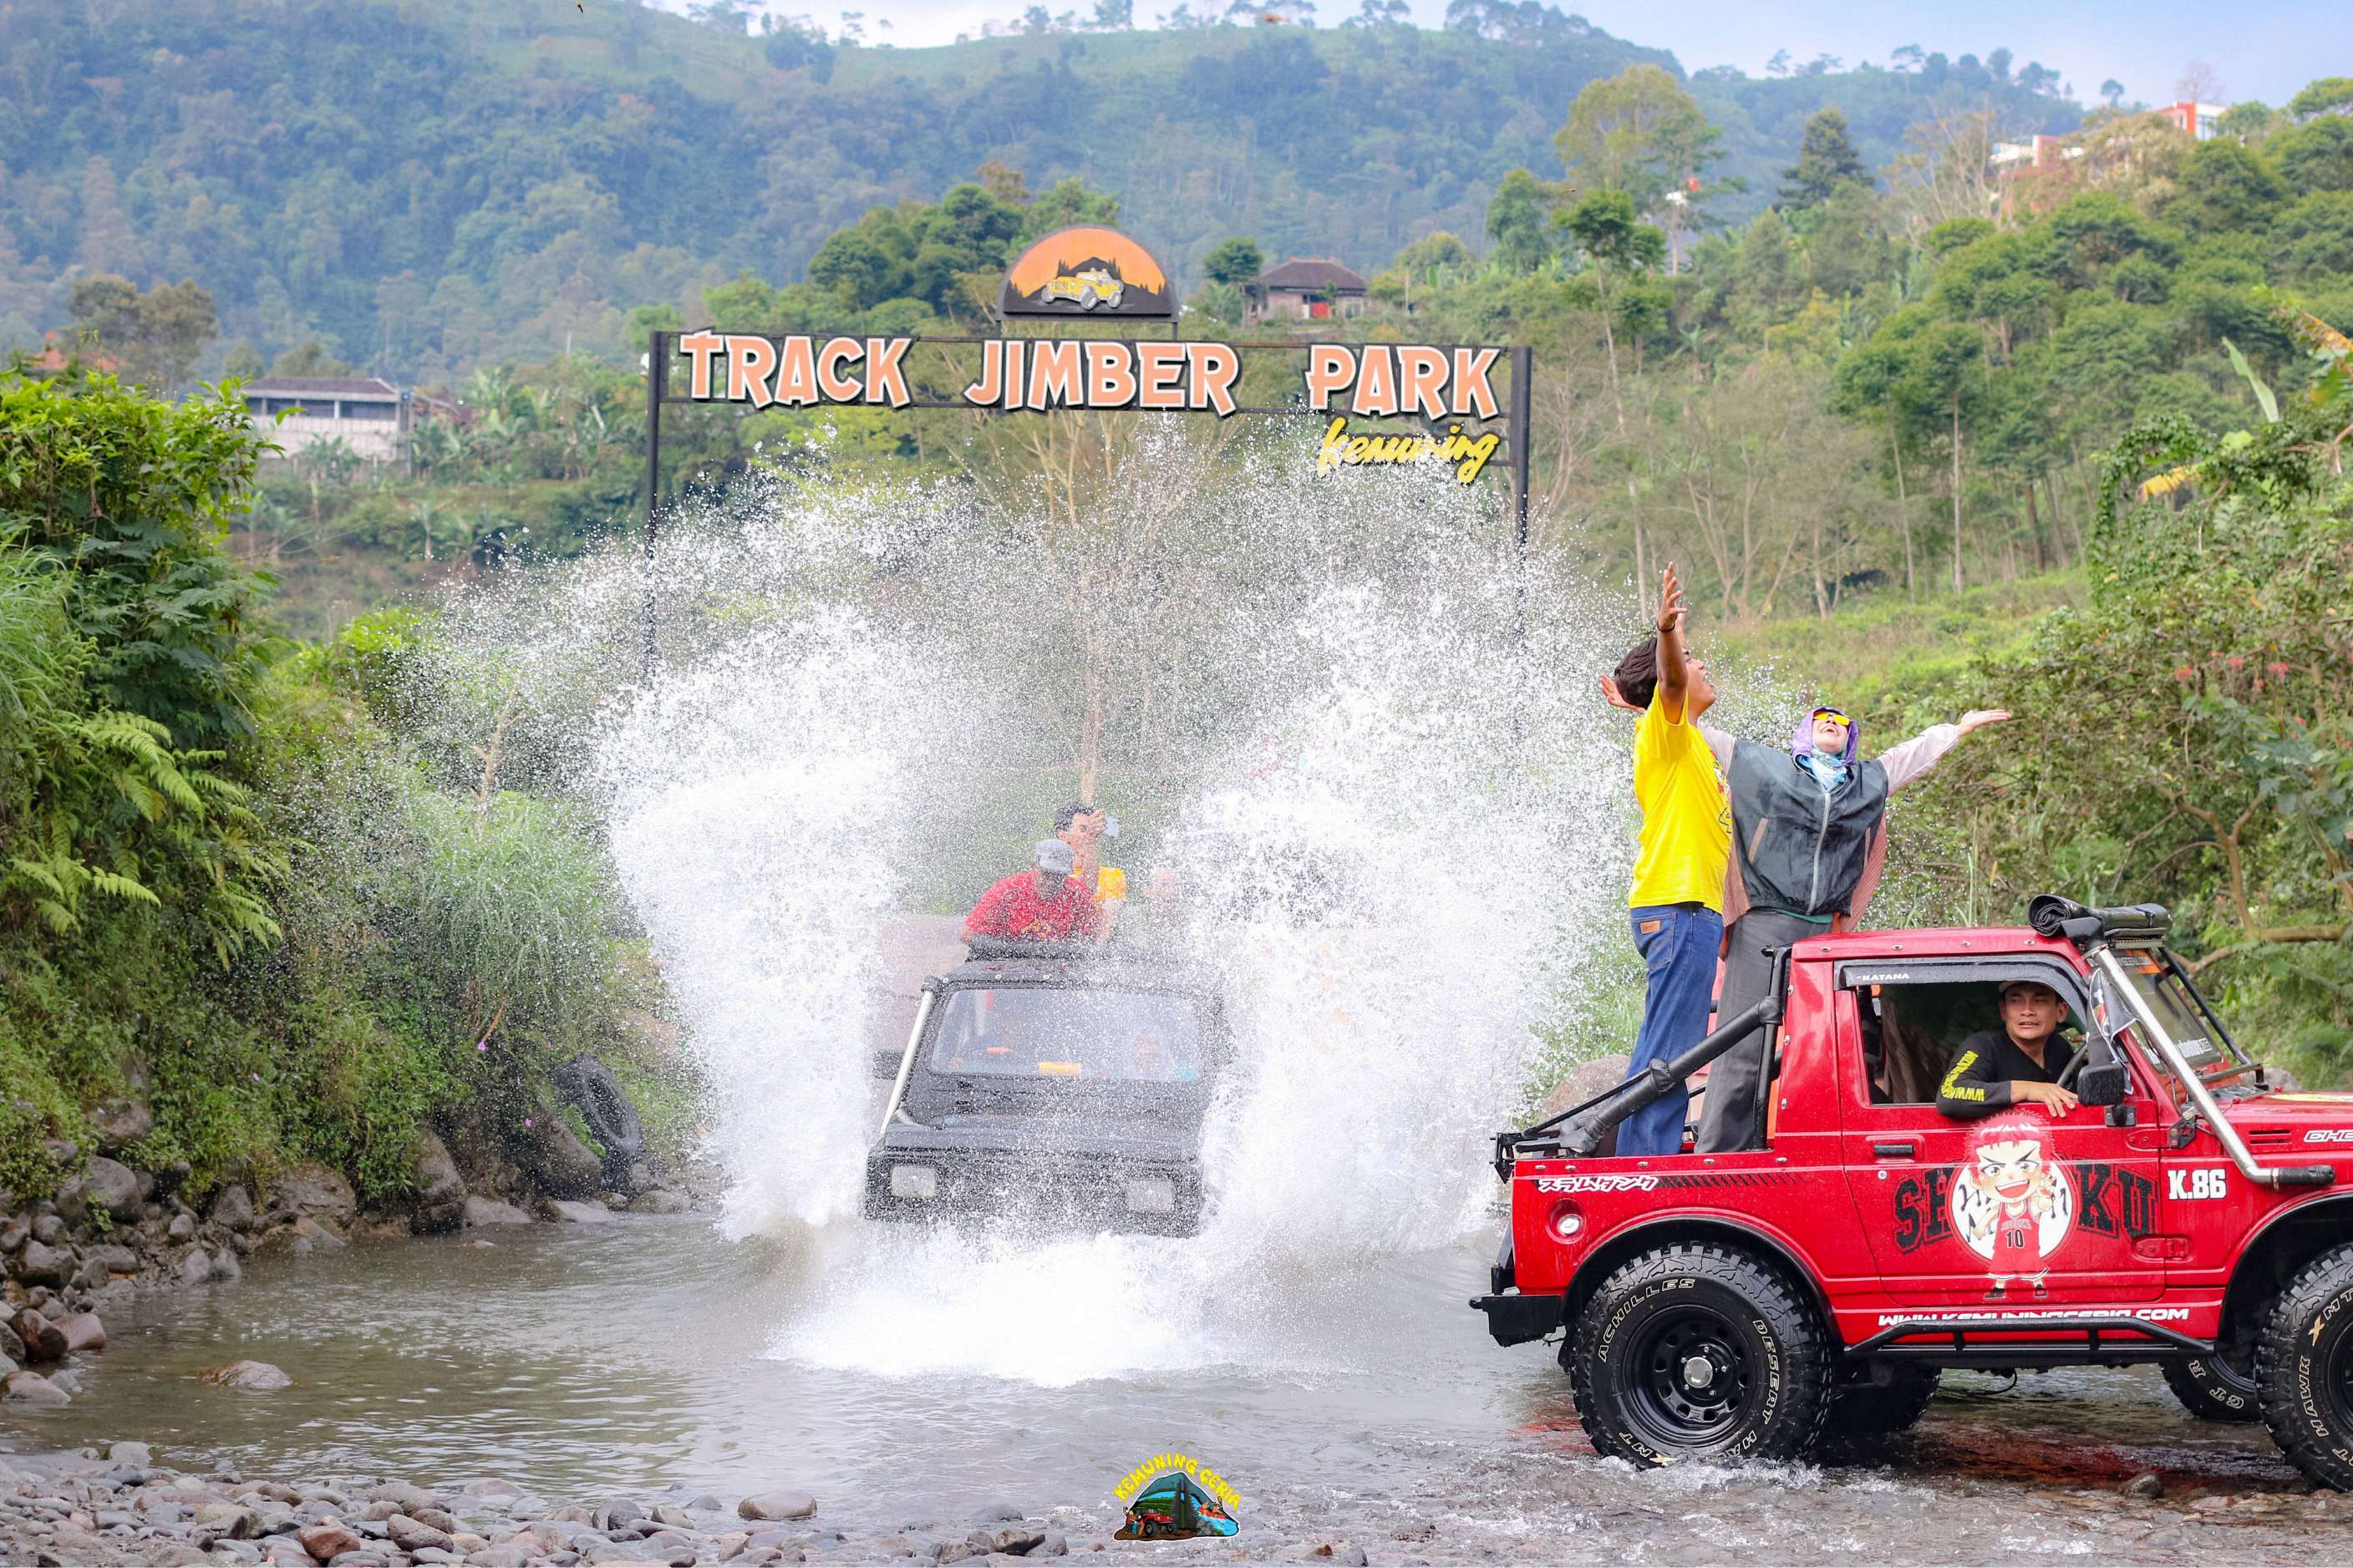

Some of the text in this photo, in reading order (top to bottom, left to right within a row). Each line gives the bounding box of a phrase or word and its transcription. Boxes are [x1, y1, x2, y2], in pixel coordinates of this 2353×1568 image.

[680, 330, 1501, 420] TRACK JIMBER PARK
[1862, 973, 1910, 982] KATANA
[1893, 1156, 2159, 1255] SHKU
[2168, 1169, 2227, 1200] K.86
[2005, 1229, 2025, 1249] 10
[1598, 1278, 1696, 1362] ACHILLES
[1718, 1319, 1780, 1458] DESERT HA
[2299, 1355, 2329, 1437] HAWK
[2323, 1288, 2353, 1320] MT
[2209, 1388, 2244, 1409] GT
[1619, 1432, 1653, 1458] MT
